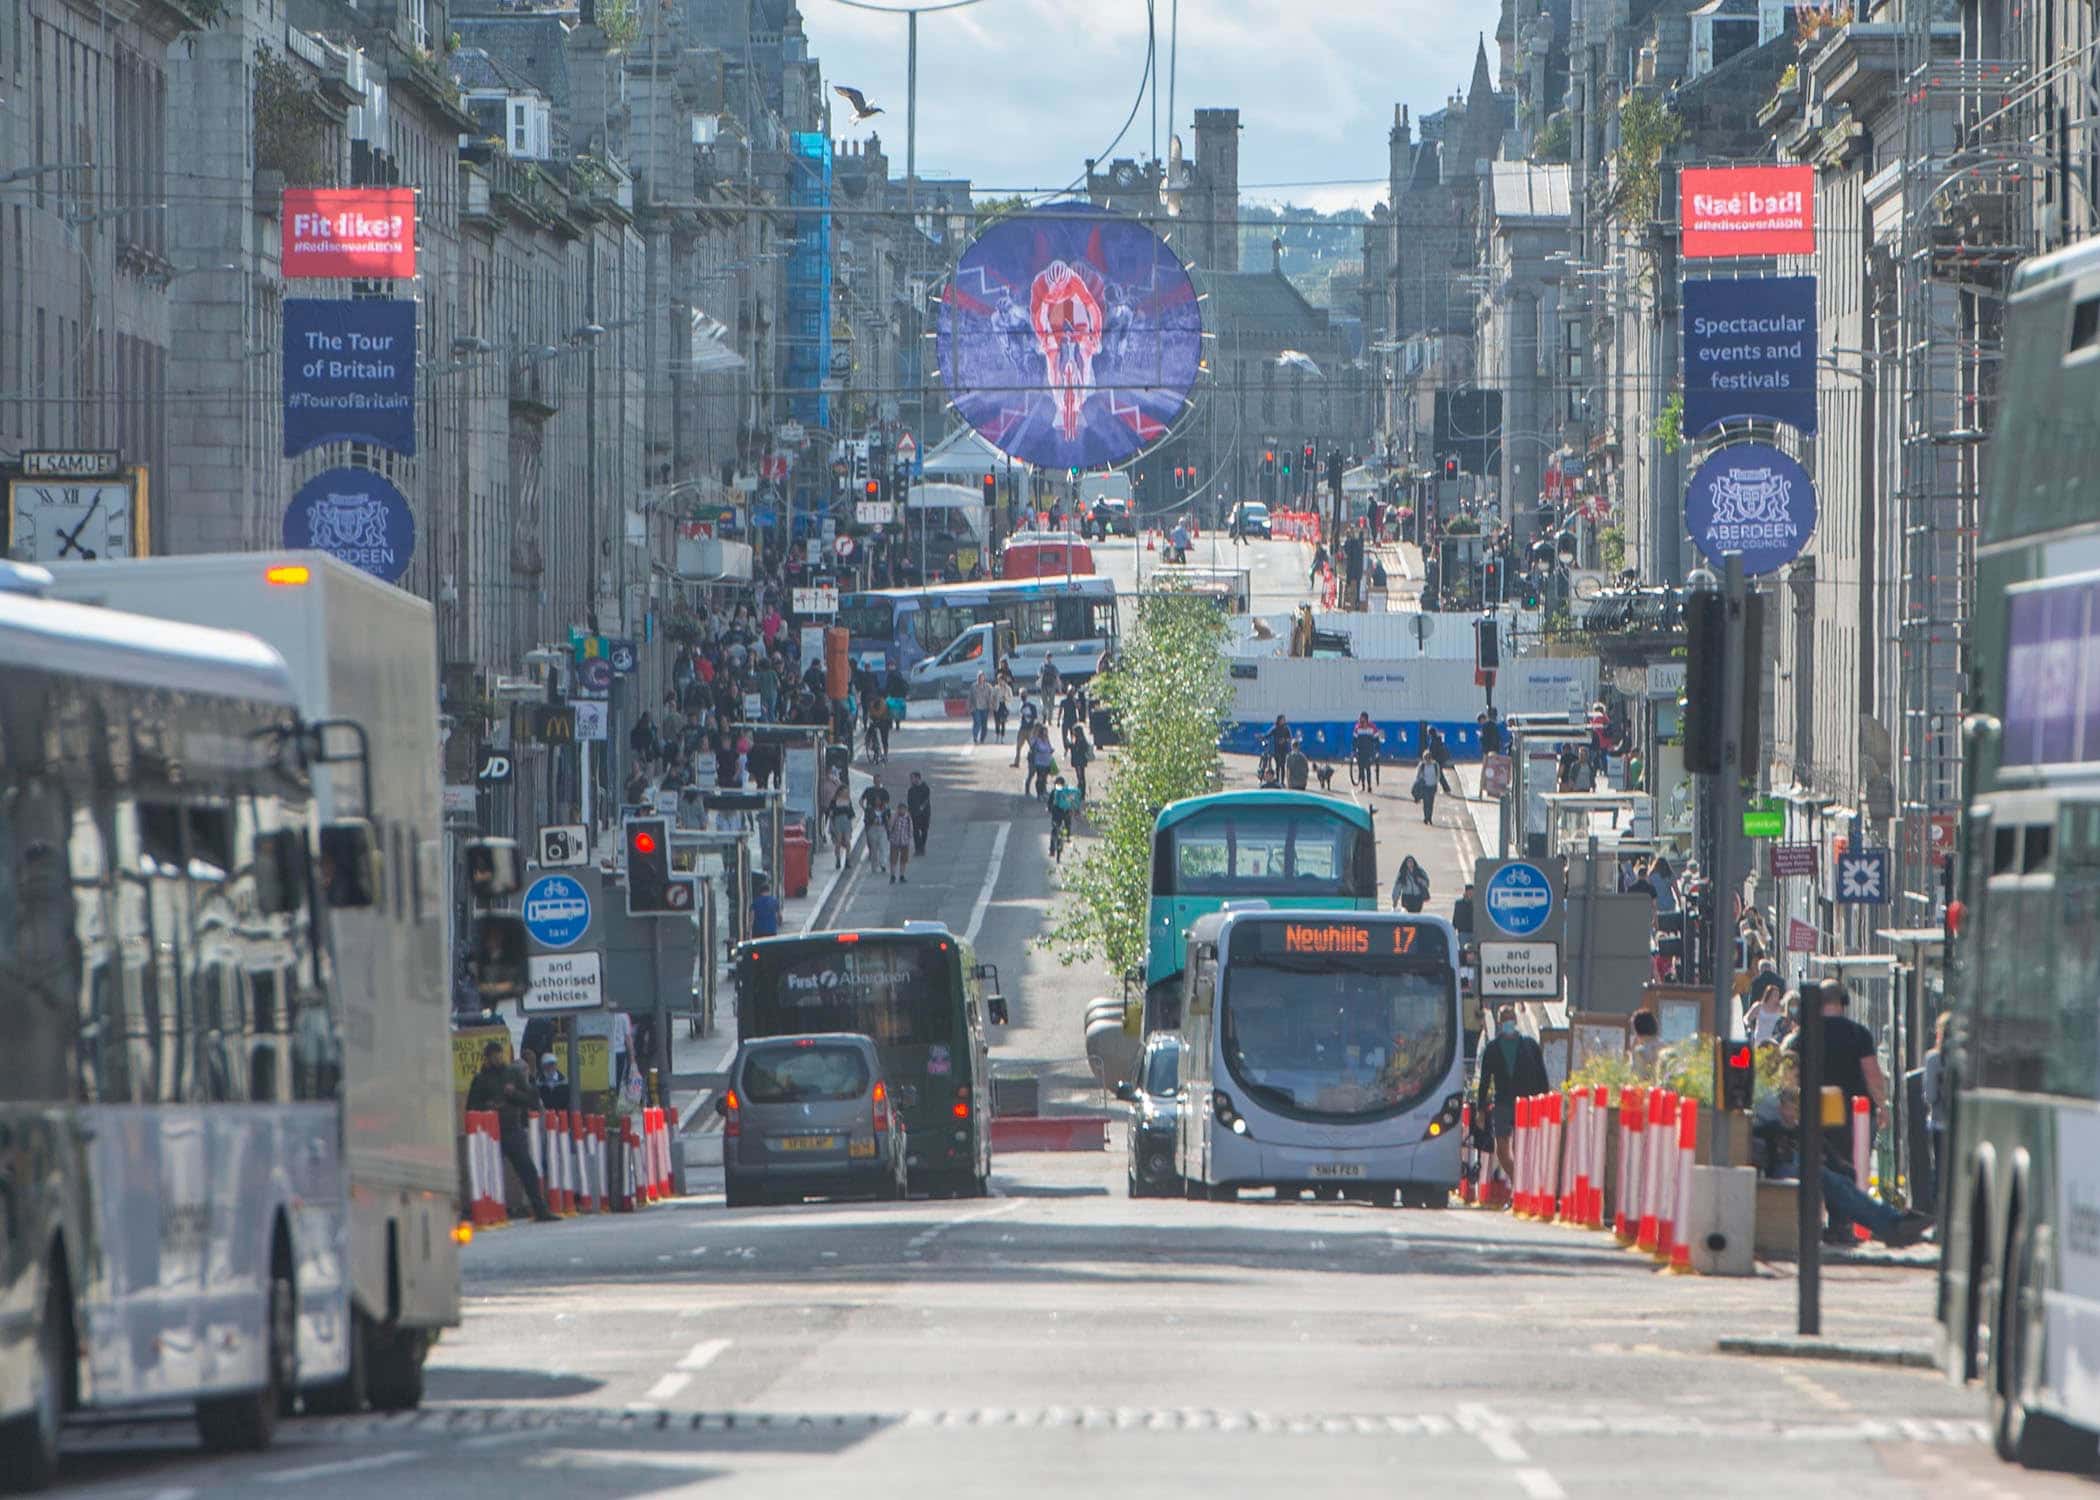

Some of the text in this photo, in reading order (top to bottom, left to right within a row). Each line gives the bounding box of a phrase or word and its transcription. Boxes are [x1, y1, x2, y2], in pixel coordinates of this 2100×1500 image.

[1694, 191, 1802, 217] Nae bad!
[294, 212, 402, 238] Fit like?
[1694, 314, 1806, 338] Spectacular
[305, 332, 394, 350] The Tour
[1699, 340, 1801, 361] events and
[303, 360, 395, 379] of Britain
[1711, 370, 1790, 389] festivals
[289, 392, 408, 408] #TourofBritain
[1706, 523, 1798, 540] ABERDEEN
[1715, 538, 1789, 550] CITY COUNCIL
[479, 756, 510, 778] JD
[1509, 915, 1530, 926] taxi
[548, 928, 569, 937] taxi
[1286, 924, 1416, 954] Newhills 17
[1506, 948, 1531, 960] and
[548, 960, 573, 973] and
[1485, 963, 1553, 975] authorised
[787, 970, 911, 989] First Aberdeen
[1493, 978, 1545, 989] vehicles
[536, 990, 589, 1003] vehicles
